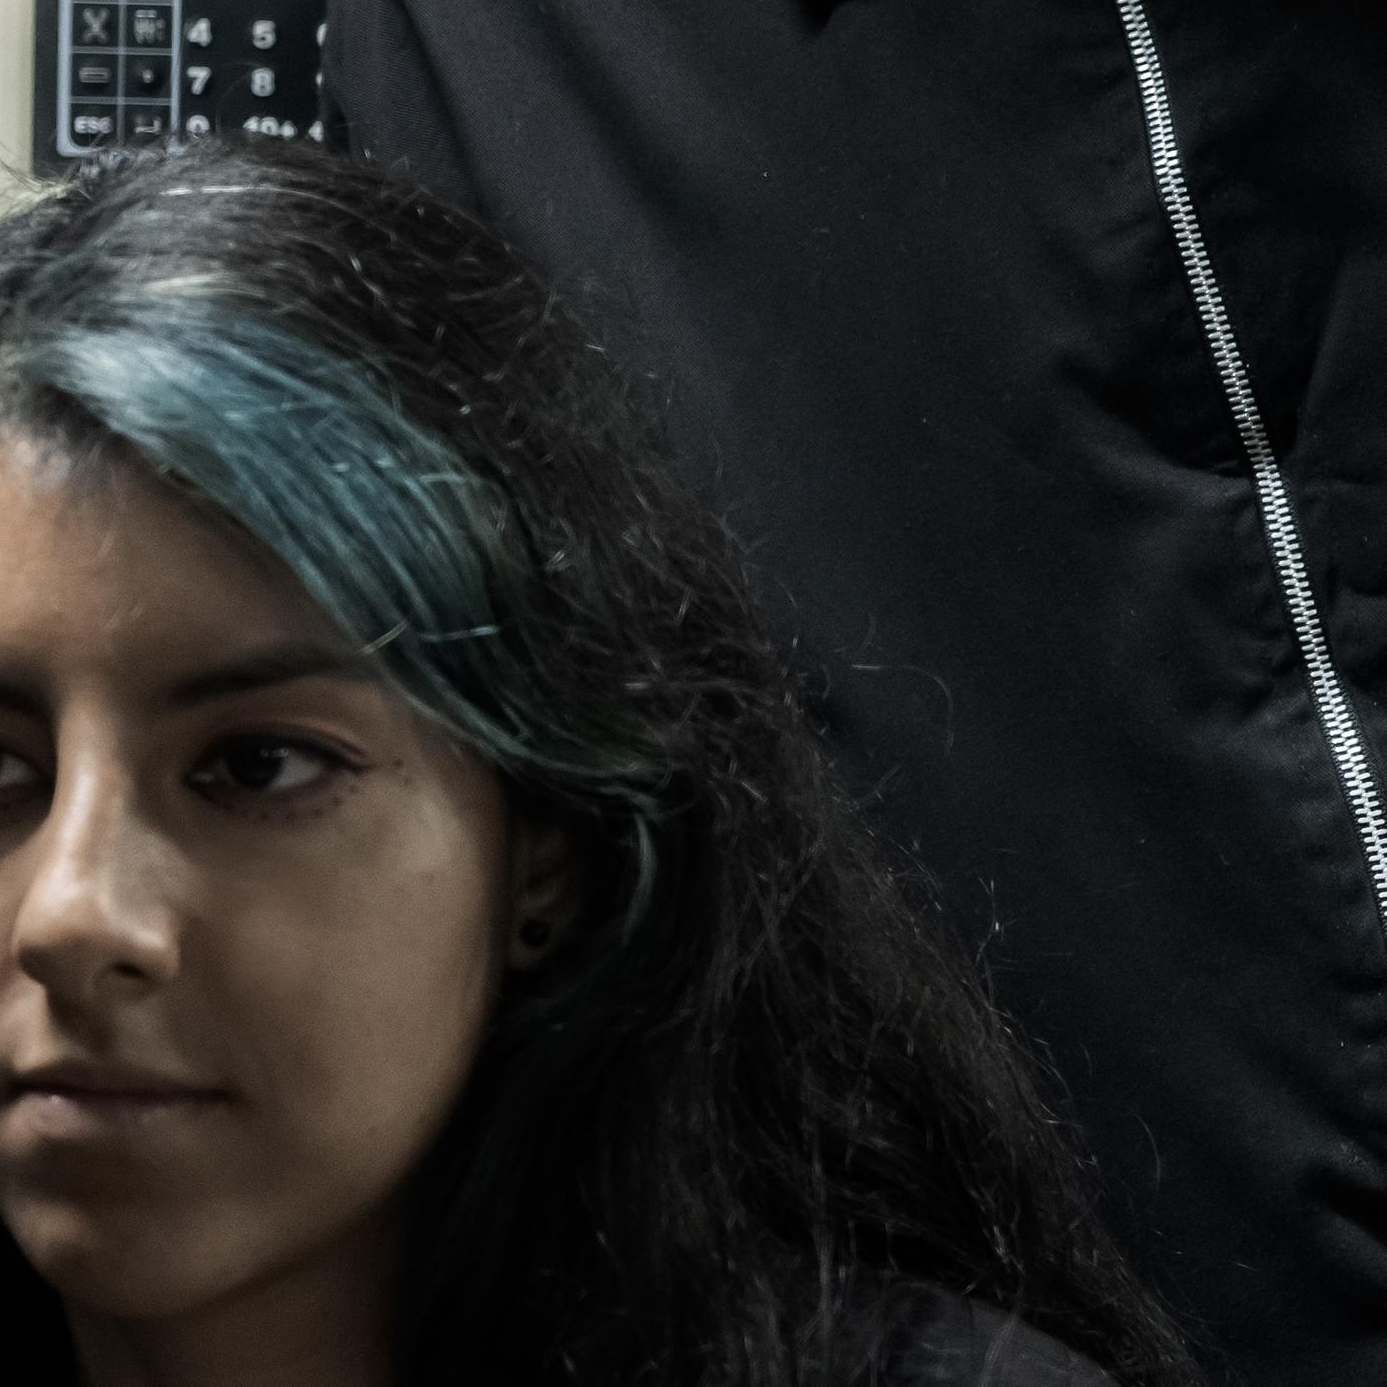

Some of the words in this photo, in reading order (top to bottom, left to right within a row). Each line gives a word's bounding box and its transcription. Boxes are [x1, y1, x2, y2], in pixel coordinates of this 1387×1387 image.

[187, 18, 212, 47] 4
[252, 20, 277, 50] 5
[186, 66, 212, 95] 7
[250, 67, 275, 97] 8
